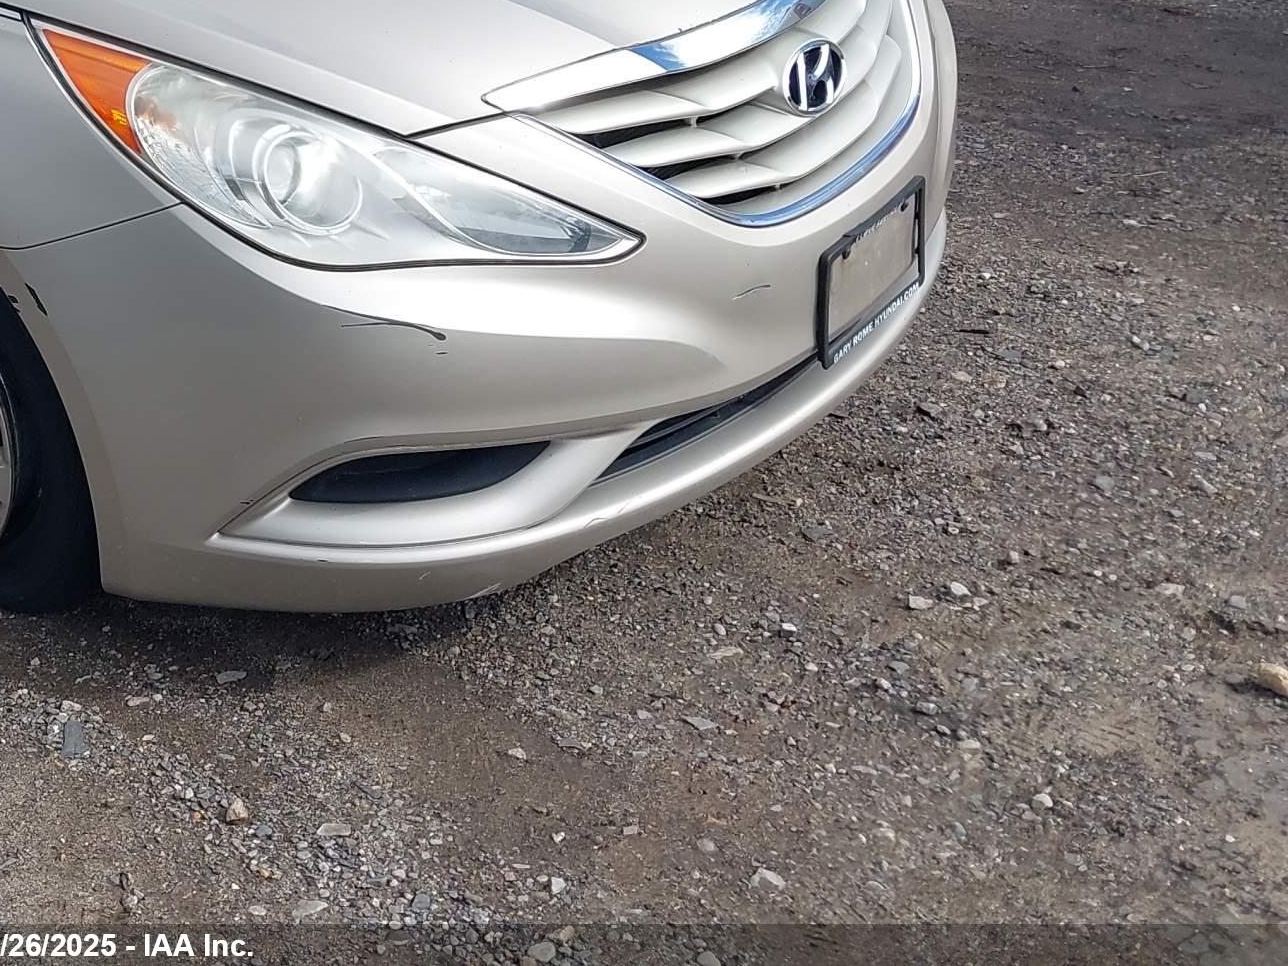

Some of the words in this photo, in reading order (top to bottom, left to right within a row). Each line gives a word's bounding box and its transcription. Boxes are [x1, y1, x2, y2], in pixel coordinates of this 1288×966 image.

[833, 339, 852, 364] GARY
[852, 321, 874, 347] ROME
[874, 281, 920, 328] HYUNDAI.COM
